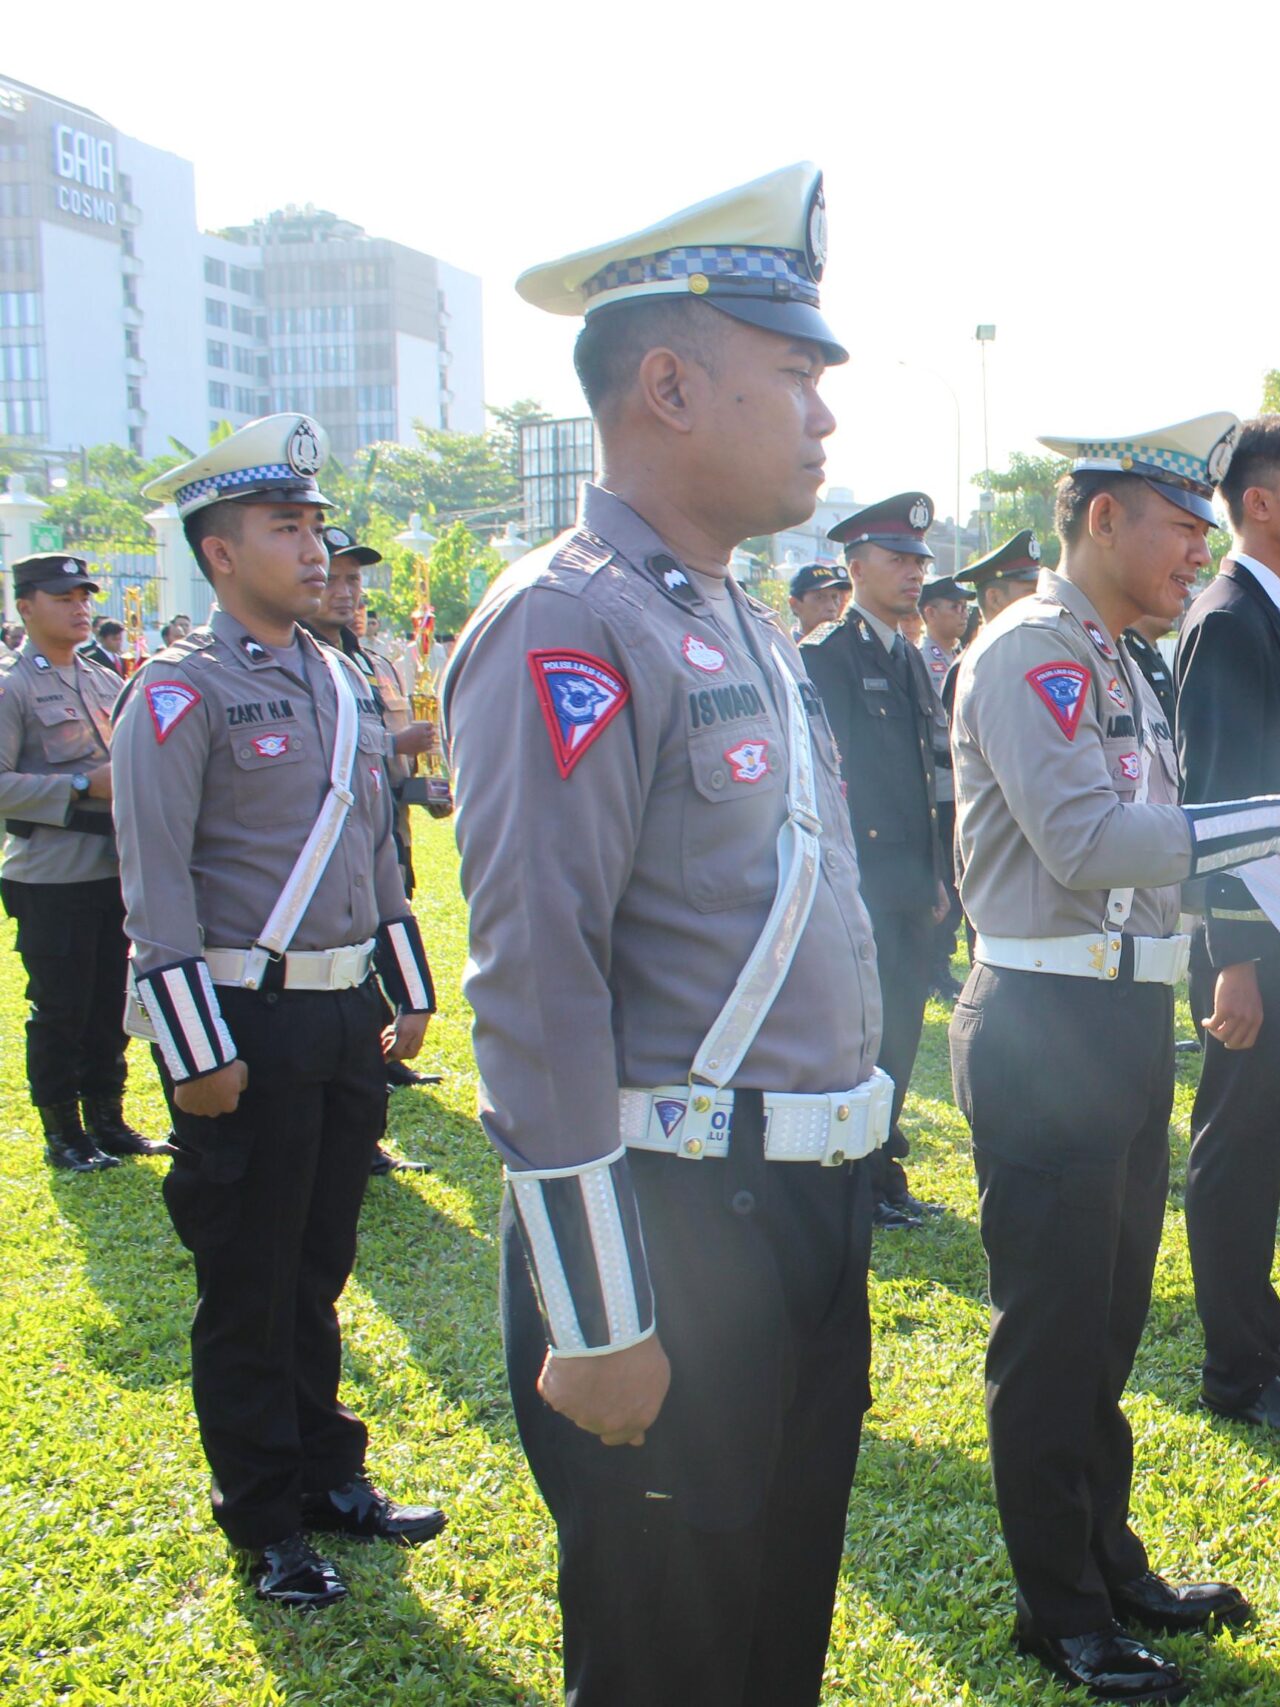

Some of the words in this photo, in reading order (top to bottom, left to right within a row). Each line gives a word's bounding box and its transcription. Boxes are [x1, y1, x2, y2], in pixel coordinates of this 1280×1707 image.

[57, 125, 115, 194] GAIA
[59, 185, 117, 226] COSMO
[227, 703, 264, 725] ZAKY
[689, 683, 766, 729] ISWADI
